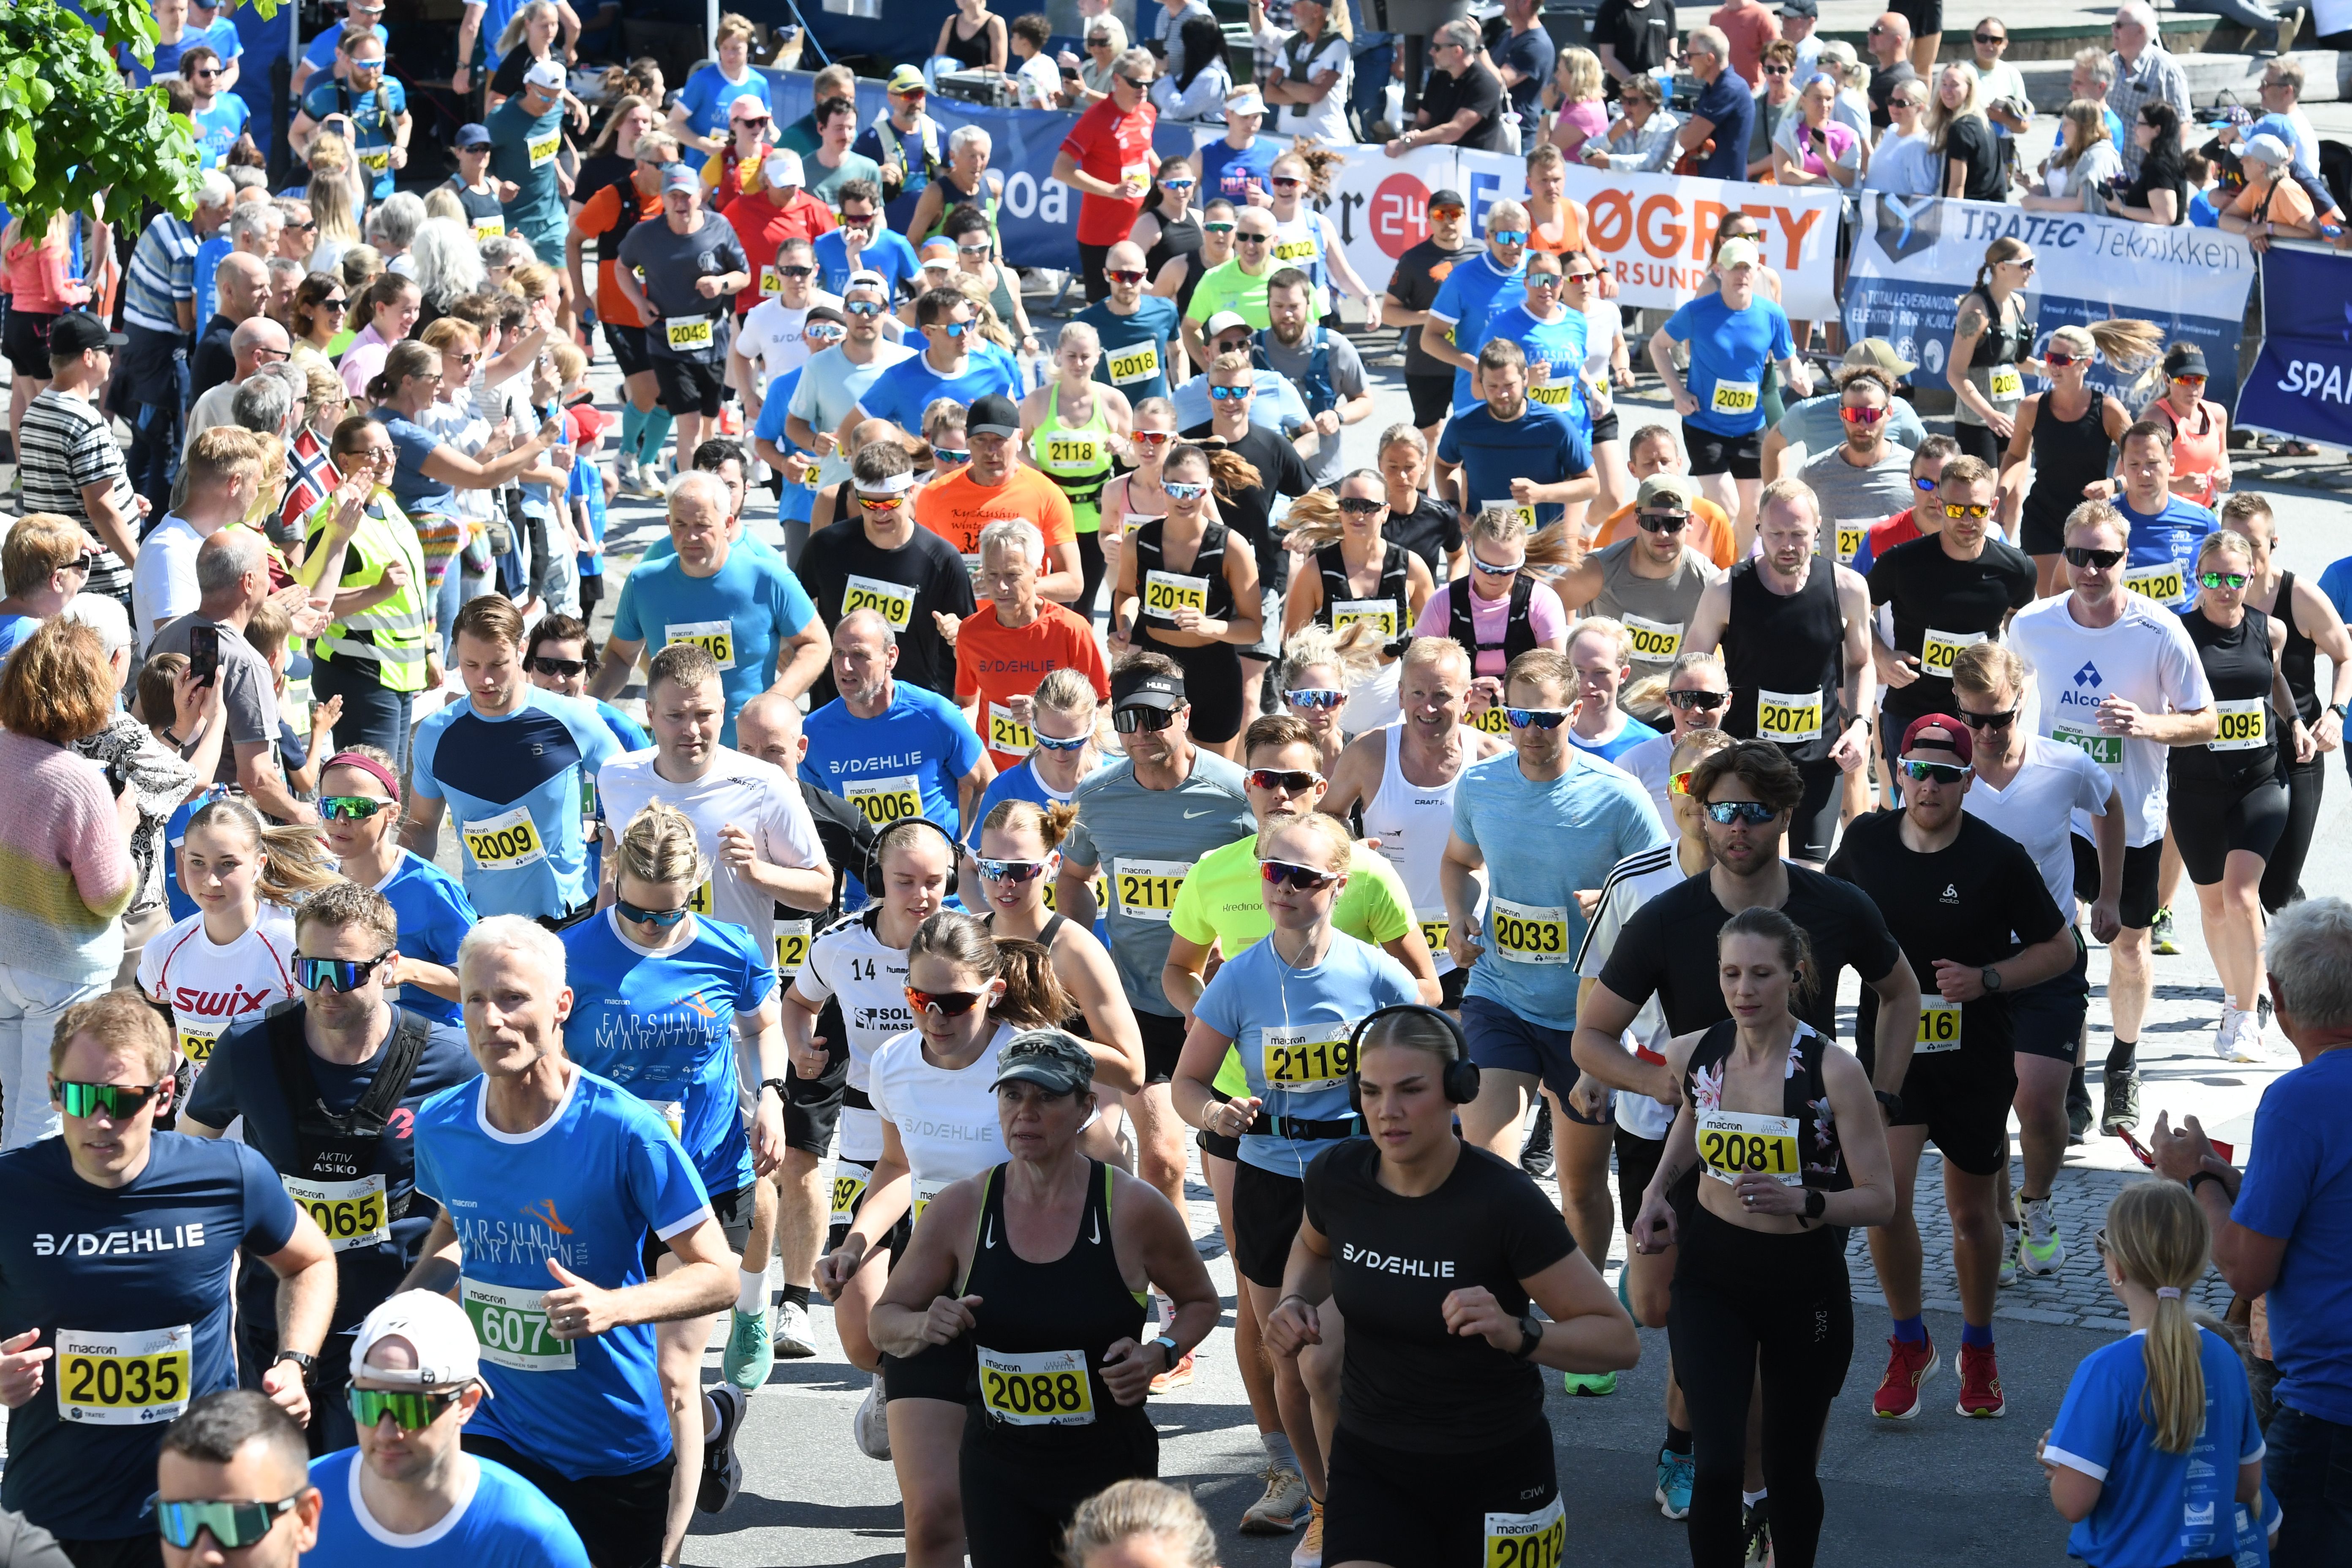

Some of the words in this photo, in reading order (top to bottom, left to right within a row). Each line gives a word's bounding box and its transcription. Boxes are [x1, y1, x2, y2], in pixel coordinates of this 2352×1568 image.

[533, 141, 558, 160] 202
[1380, 194, 1427, 238] 24
[1962, 209, 2085, 248] TRATEC
[2096, 224, 2240, 270] Teknikken
[1278, 242, 1312, 260] 2122
[1602, 259, 1706, 291] RSUND
[671, 324, 707, 343] 2048
[1113, 353, 1154, 377] 2018
[1532, 387, 1568, 404] 2077
[1718, 390, 1752, 407] 2031
[1051, 442, 1092, 460] 2118
[1841, 532, 1867, 553] 21
[853, 583, 878, 592] macron
[1150, 584, 1200, 610] 2015
[848, 590, 905, 623] 2019
[1627, 620, 1651, 630] macron
[2138, 619, 2158, 632] CRAFT
[670, 636, 727, 660] 46
[1931, 635, 1955, 645] macron
[1927, 643, 1966, 667] 20
[1764, 697, 1788, 706] macron
[2061, 690, 2101, 708] Alco
[1762, 706, 1814, 732] 2071
[2215, 714, 2261, 740] 095
[994, 719, 1029, 746] 211
[2058, 725, 2083, 735] macron
[2112, 753, 2118, 763] 1
[727, 776, 751, 787] CRAFT
[472, 825, 531, 860] 2009
[1122, 866, 1152, 875] macron
[1495, 906, 1521, 918] macron
[1423, 923, 1450, 949] 57
[1496, 916, 1560, 952] 2033
[776, 937, 803, 965] 12
[851, 958, 876, 981] 14
[886, 965, 910, 975] humme
[604, 998, 631, 1006] macron
[879, 1007, 913, 1020] SOL
[183, 1027, 214, 1037] macron
[1920, 1011, 1953, 1040] 16
[1271, 1036, 1306, 1045] macron
[1273, 1042, 1350, 1080] 2119
[1707, 1121, 1742, 1131] macron
[317, 1152, 353, 1163] AKTIV
[1705, 1132, 1785, 1171] 2081
[289, 1186, 325, 1200] macron
[832, 1179, 856, 1211] 69
[920, 1192, 936, 1200] mac
[452, 1198, 477, 1208] macron
[295, 1196, 378, 1236] 065
[577, 1242, 588, 1266] 2024
[470, 1289, 507, 1305] macron
[482, 1307, 547, 1353] 607
[556, 1339, 566, 1353] 1
[69, 1343, 117, 1355] macron
[985, 1358, 1021, 1373] macron
[70, 1357, 179, 1405] 2035
[988, 1372, 1081, 1413] 2088
[1062, 1416, 1085, 1424] Alcoa
[1497, 1523, 1538, 1535] macron
[1497, 1522, 1563, 1568] 2012
